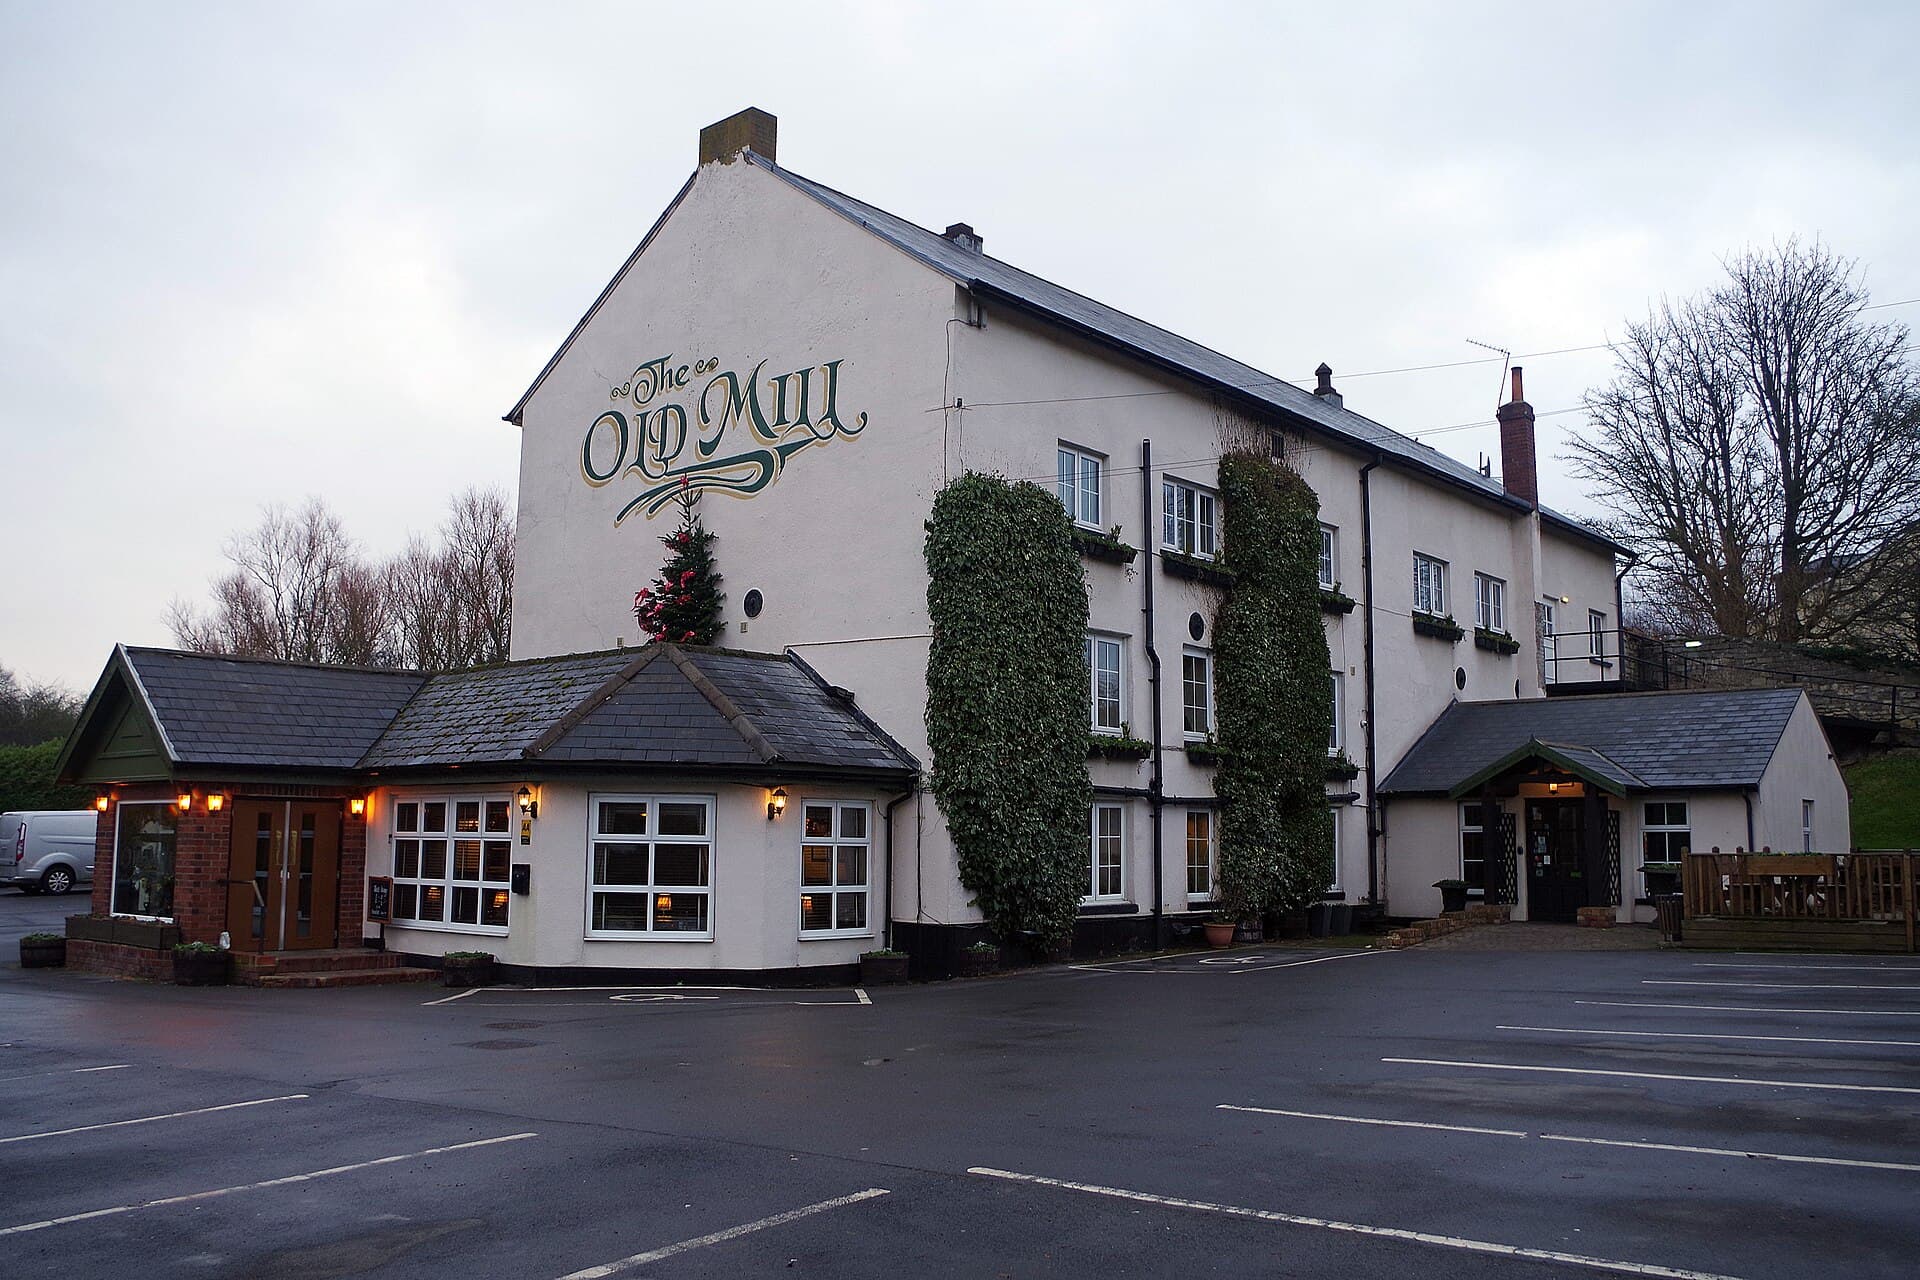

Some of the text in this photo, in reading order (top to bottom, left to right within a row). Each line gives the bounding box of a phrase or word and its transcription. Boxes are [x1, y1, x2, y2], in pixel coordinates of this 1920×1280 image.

[581, 358, 868, 486] OLD MILL
[631, 353, 690, 405] The
